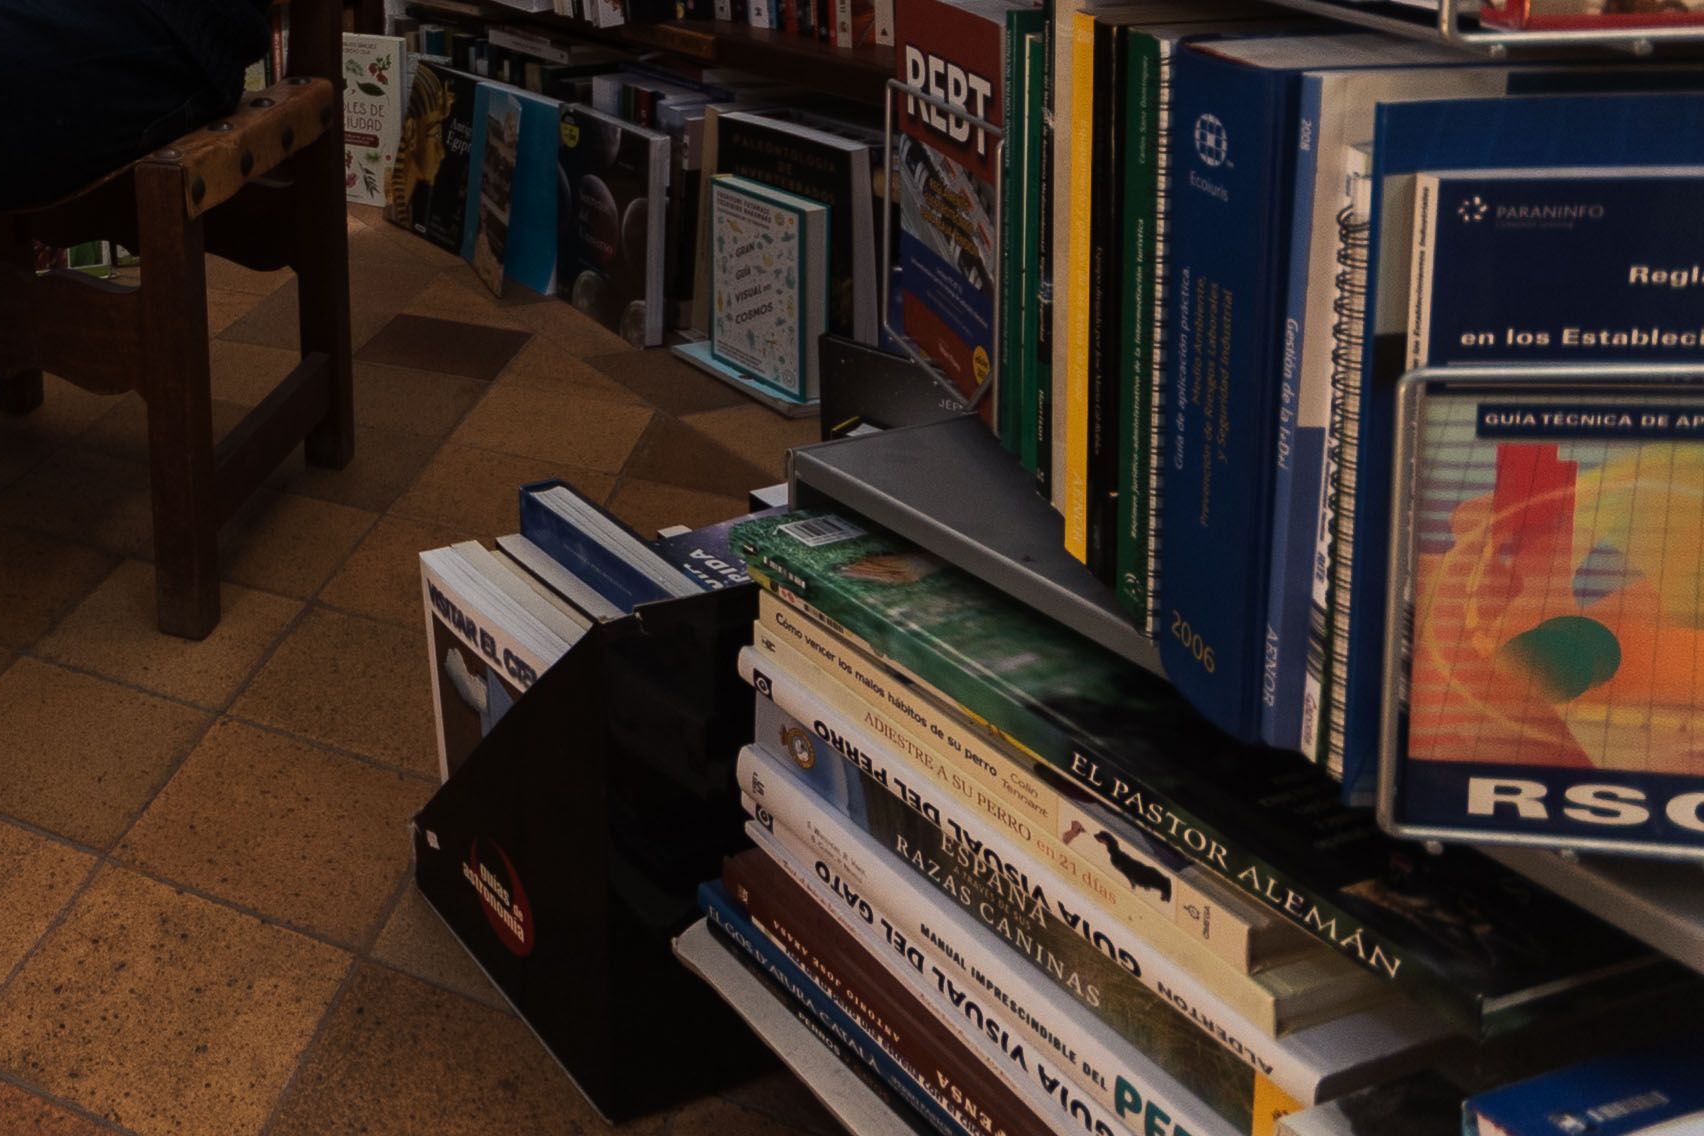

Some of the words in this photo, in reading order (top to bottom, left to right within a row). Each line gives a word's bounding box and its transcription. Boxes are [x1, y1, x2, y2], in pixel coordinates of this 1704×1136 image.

[905, 44, 992, 156] REBT
[719, 205, 729, 213] GRAN
[1188, 169, 1231, 203] Ecoiuris
[1496, 204, 1605, 219] PARANINFO
[719, 224, 732, 233] VISUAL
[719, 233, 737, 243] COSMOS
[1279, 317, 1302, 371] Gestión
[1460, 329, 1496, 347] en
[1506, 327, 1552, 346] los
[1485, 410, 1536, 426] GUÍA
[1540, 411, 1633, 426] TÉCNICA
[1641, 415, 1670, 426] DE
[1168, 610, 1217, 676] 2006
[1260, 621, 1282, 711] AENOR
[775, 612, 804, 640] Cómo
[805, 634, 844, 666] vencer
[837, 657, 854, 676] los
[855, 670, 886, 698] malos
[887, 692, 929, 729] hábitos
[929, 723, 946, 741] de
[947, 734, 963, 753] su
[963, 749, 998, 777] perro
[813, 719, 888, 787] PERRO
[1009, 773, 1039, 799] Colin
[863, 711, 935, 771] ADIESTRE
[952, 773, 974, 799] SU
[976, 800, 1033, 841] PERRO
[1036, 838, 1058, 860] en
[1081, 869, 1118, 906] días
[893, 778, 942, 823] DEL
[1000, 778, 1051, 819] Tennant
[814, 859, 873, 925] GATO
[947, 819, 1052, 916] VISUAL
[1069, 751, 1105, 786] EL
[1112, 777, 1230, 870] PASTOR
[1237, 865, 1403, 981] ALEMÁN
[880, 917, 927, 980] DEL
[895, 833, 972, 906] RAZAS
[979, 901, 1101, 1009] CANINAS
[920, 923, 966, 972] MANUAL
[969, 964, 1078, 1068] IMPRESCINDIBLE
[1082, 1063, 1109, 1091] DEL
[932, 965, 1029, 1074] VISUAL
[1156, 981, 1273, 1076] ALDERTON
